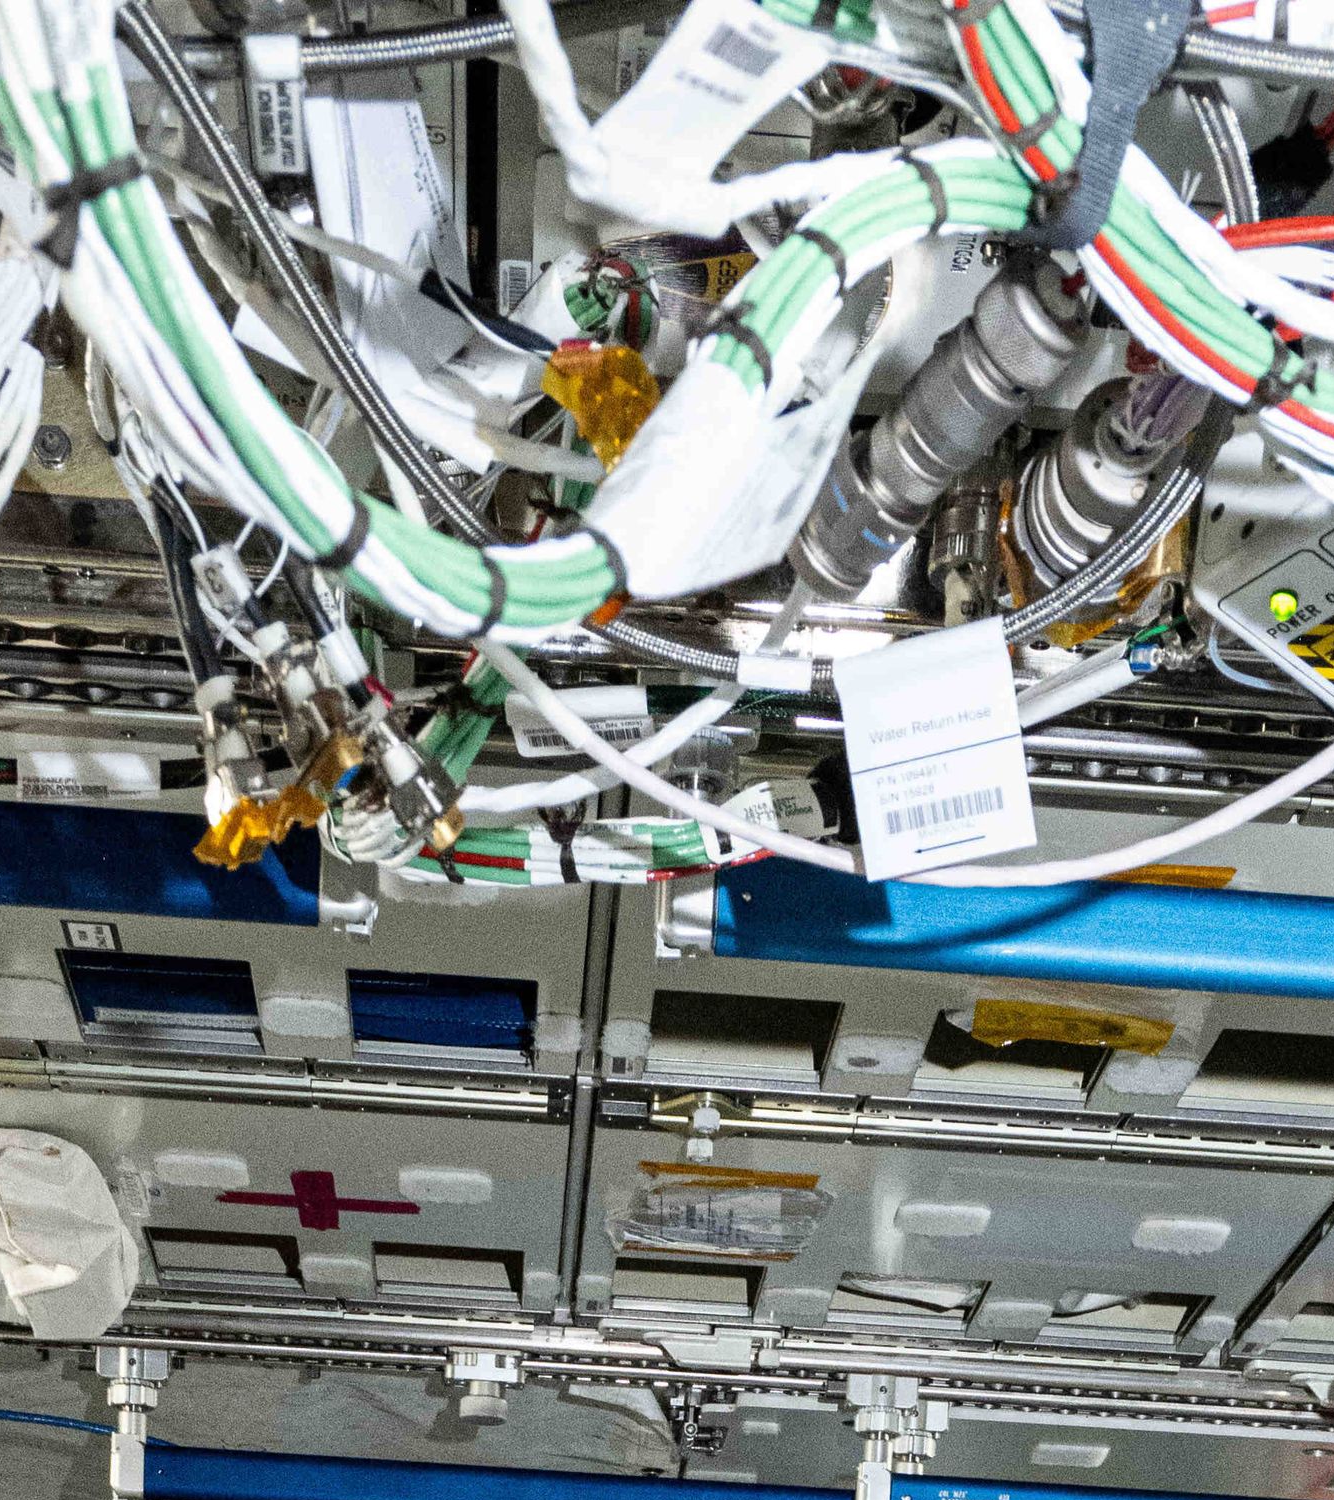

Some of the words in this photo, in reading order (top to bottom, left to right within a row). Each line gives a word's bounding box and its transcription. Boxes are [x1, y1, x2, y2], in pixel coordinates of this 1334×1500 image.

[1267, 604, 1321, 639] POWER
[869, 727, 908, 746] Water
[911, 717, 956, 734] Return
[958, 707, 992, 725] Hose
